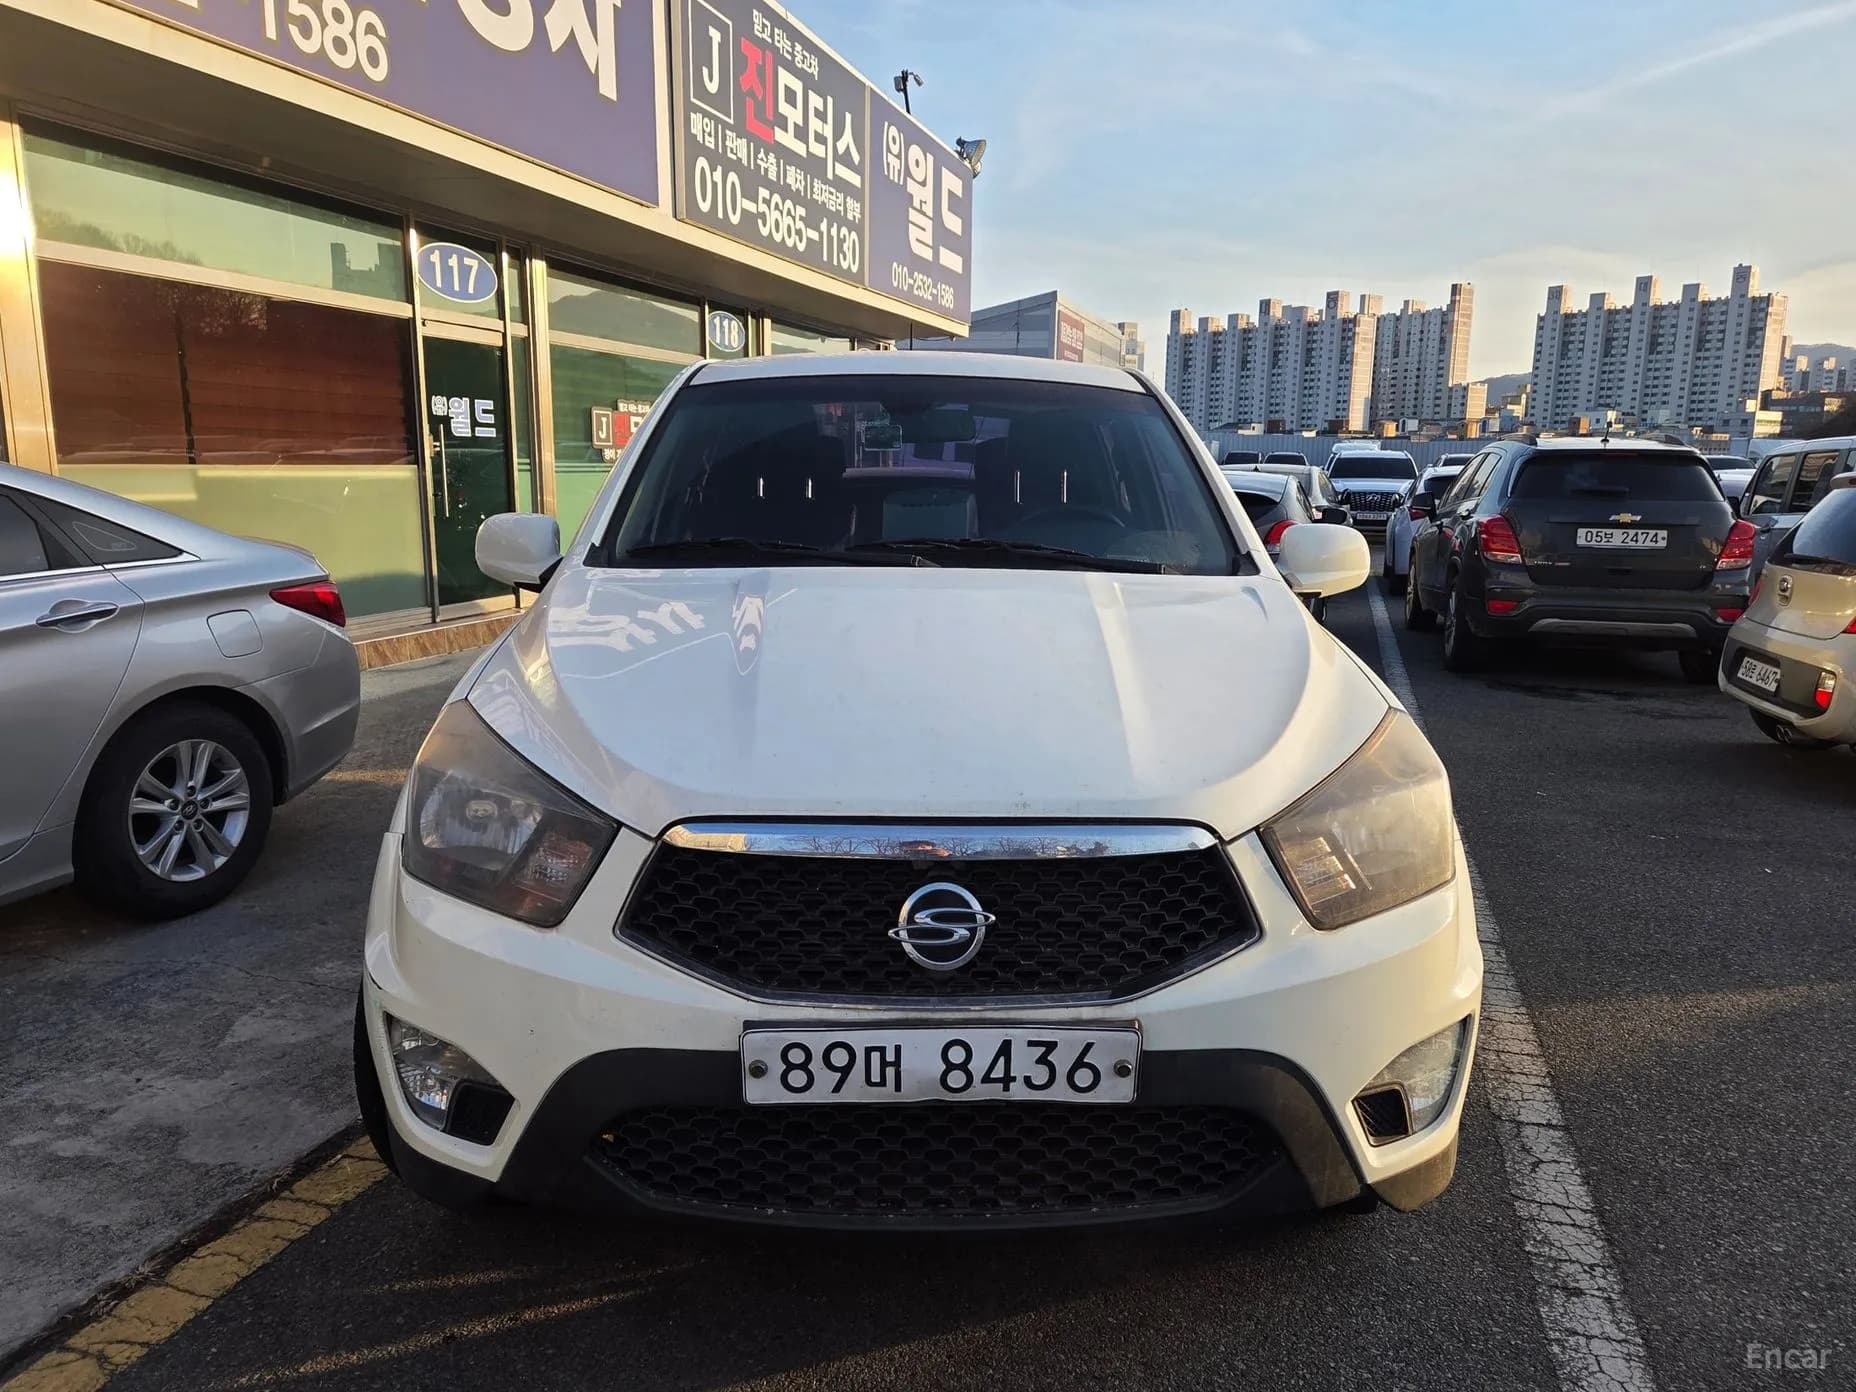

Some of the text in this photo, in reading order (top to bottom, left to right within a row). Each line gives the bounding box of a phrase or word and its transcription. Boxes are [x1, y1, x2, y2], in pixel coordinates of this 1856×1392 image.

[702, 25, 722, 94] J
[753, 9, 818, 80] 믿고 타는 중고차
[740, 36, 862, 189] 진모터스
[690, 111, 715, 149] 매입
[725, 129, 748, 167] 판매
[757, 147, 777, 182] 수출
[785, 164, 805, 197] 폐차
[846, 195, 861, 223] 할부
[694, 156, 860, 274] 010-5665-1130
[429, 248, 479, 295] 117
[892, 261, 955, 310] 010-2532-1586
[713, 315, 739, 348] 118
[598, 416, 608, 439] J
[1585, 530, 1659, 545] 05보 2474
[780, 1038, 1101, 1094] 89머 8436
